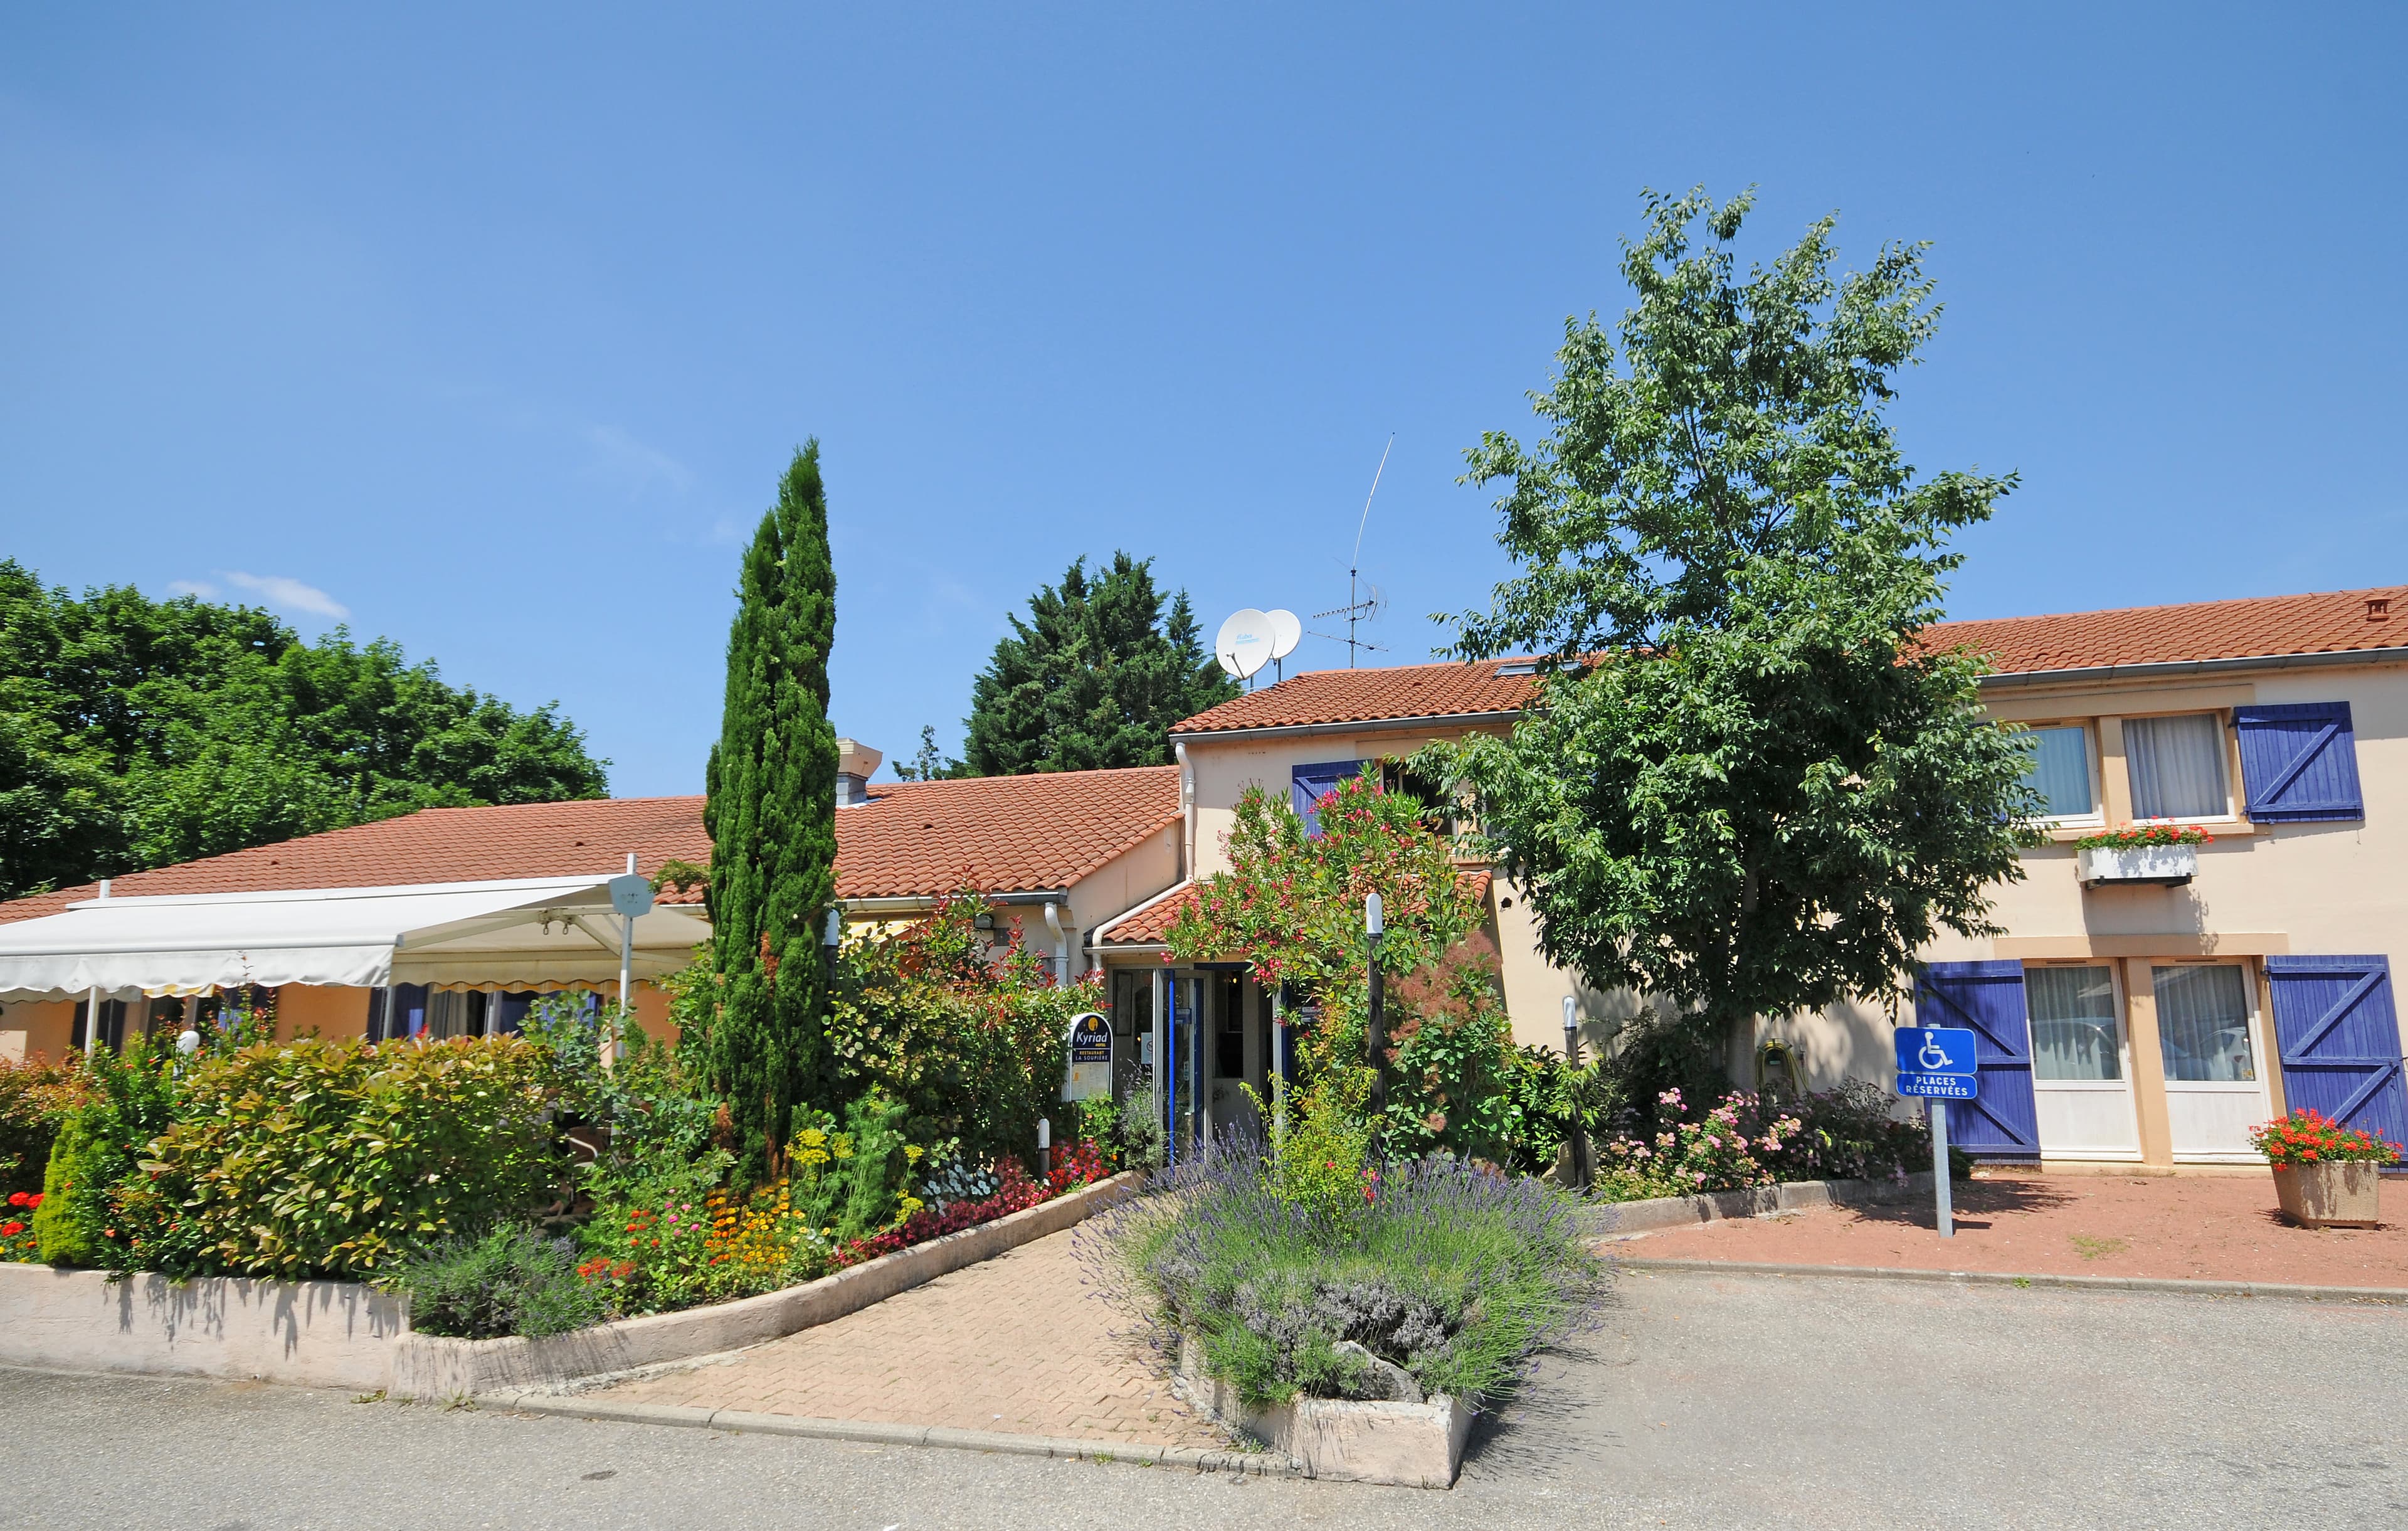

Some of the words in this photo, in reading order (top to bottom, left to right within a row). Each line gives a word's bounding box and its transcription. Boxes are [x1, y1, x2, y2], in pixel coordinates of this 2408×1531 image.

[1076, 1032, 1108, 1046] Kyriad
[1916, 1076, 1956, 1086] PLACES
[1906, 1084, 1968, 1096] RÉSERVÉES
